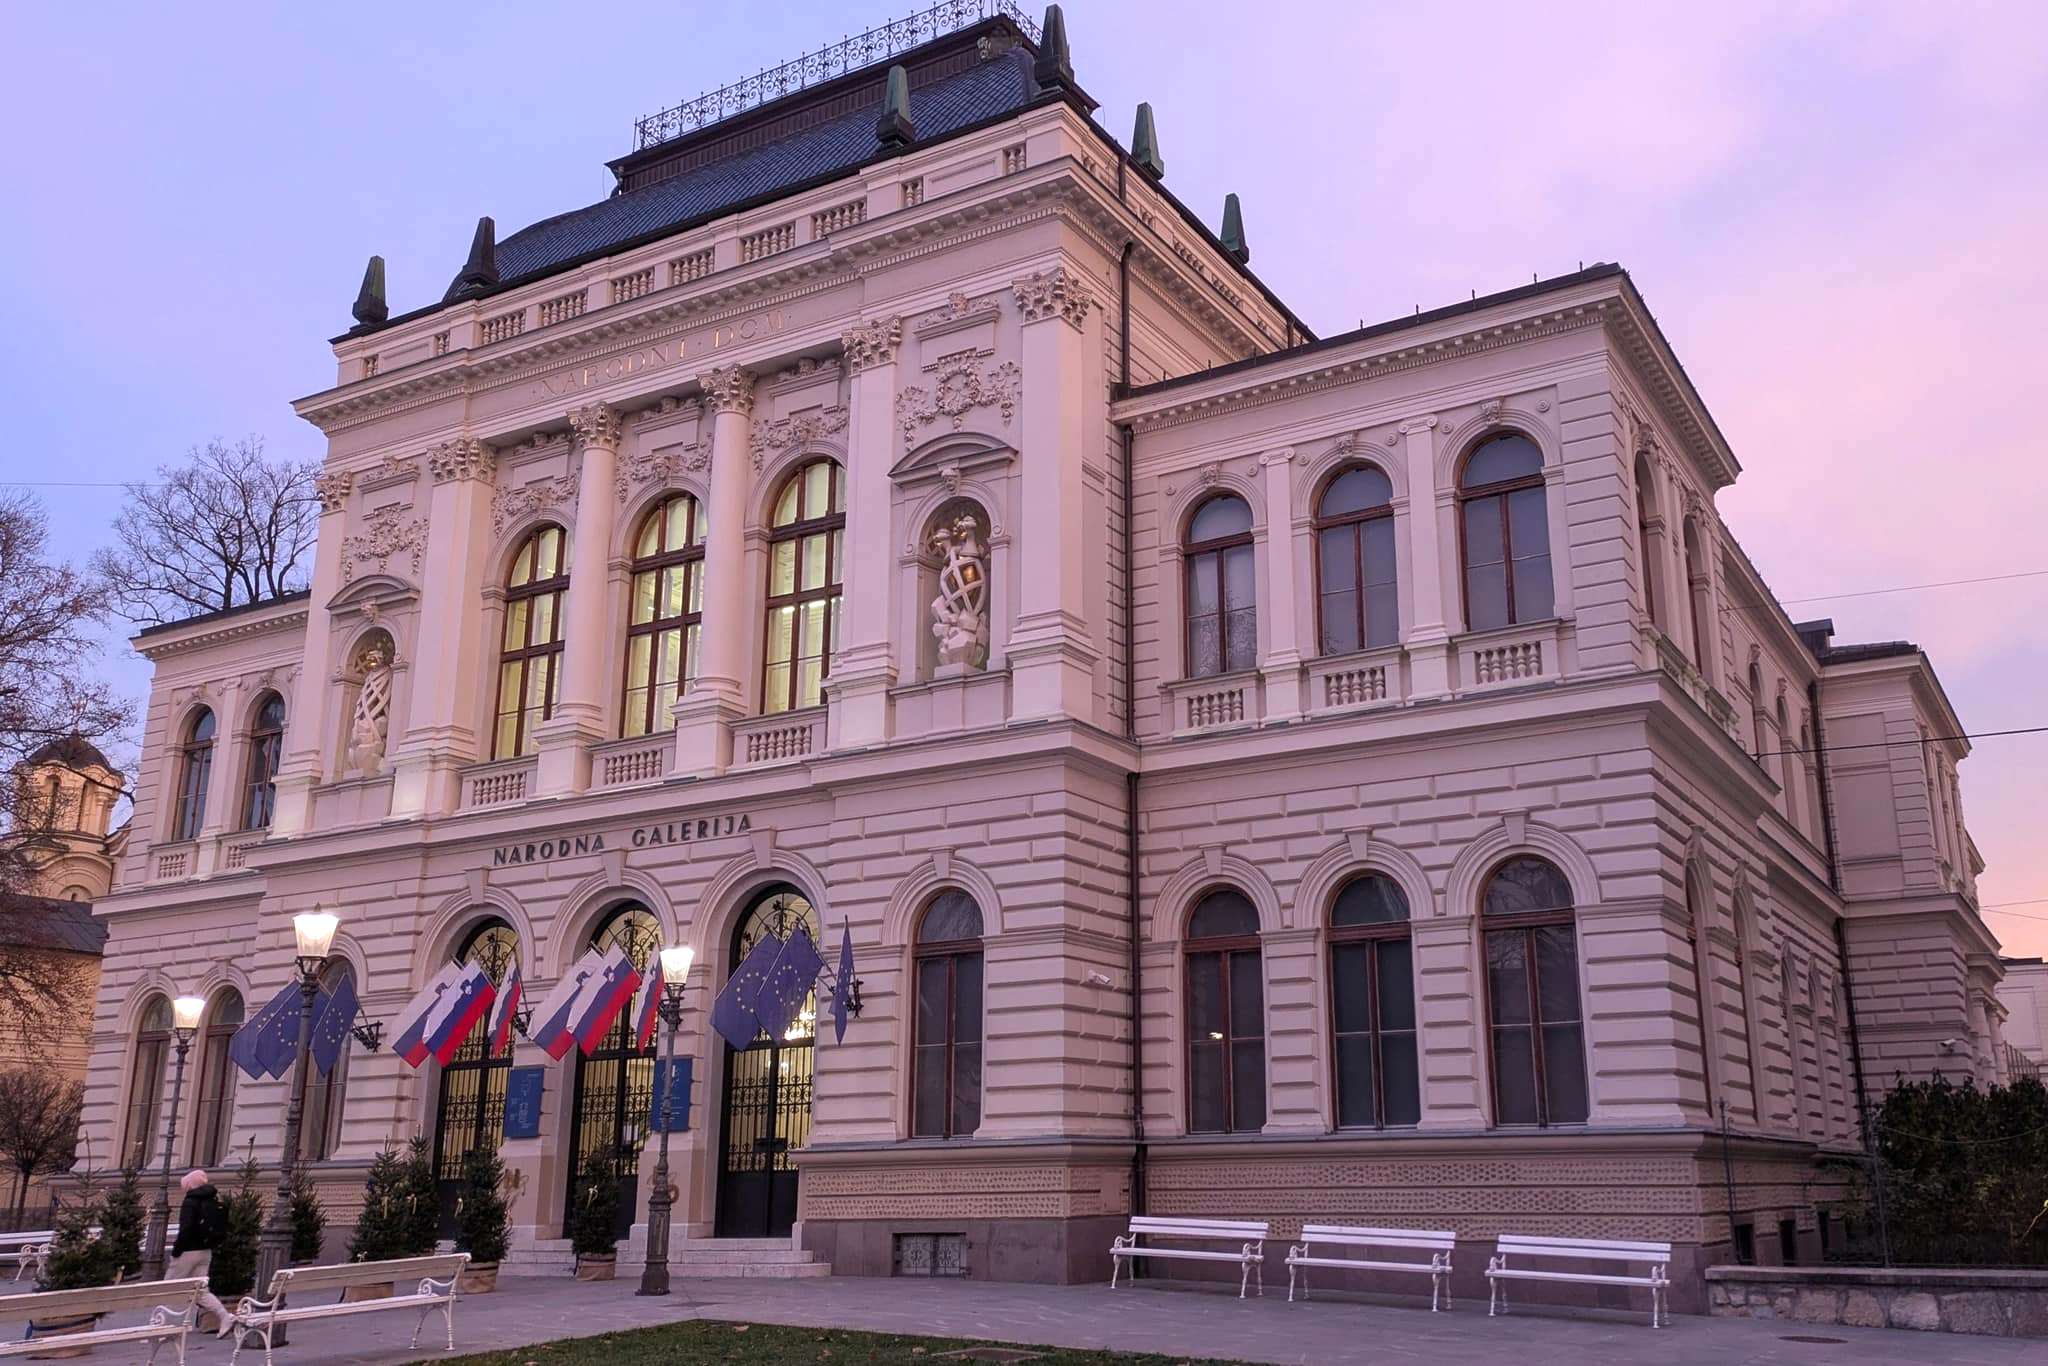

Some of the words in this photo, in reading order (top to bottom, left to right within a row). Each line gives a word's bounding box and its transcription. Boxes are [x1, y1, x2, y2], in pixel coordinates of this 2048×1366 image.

[541, 339, 686, 396] NARODNI
[713, 311, 784, 349] DOM
[493, 834, 605, 866] NARODNA
[632, 814, 751, 847] GALERIJA
